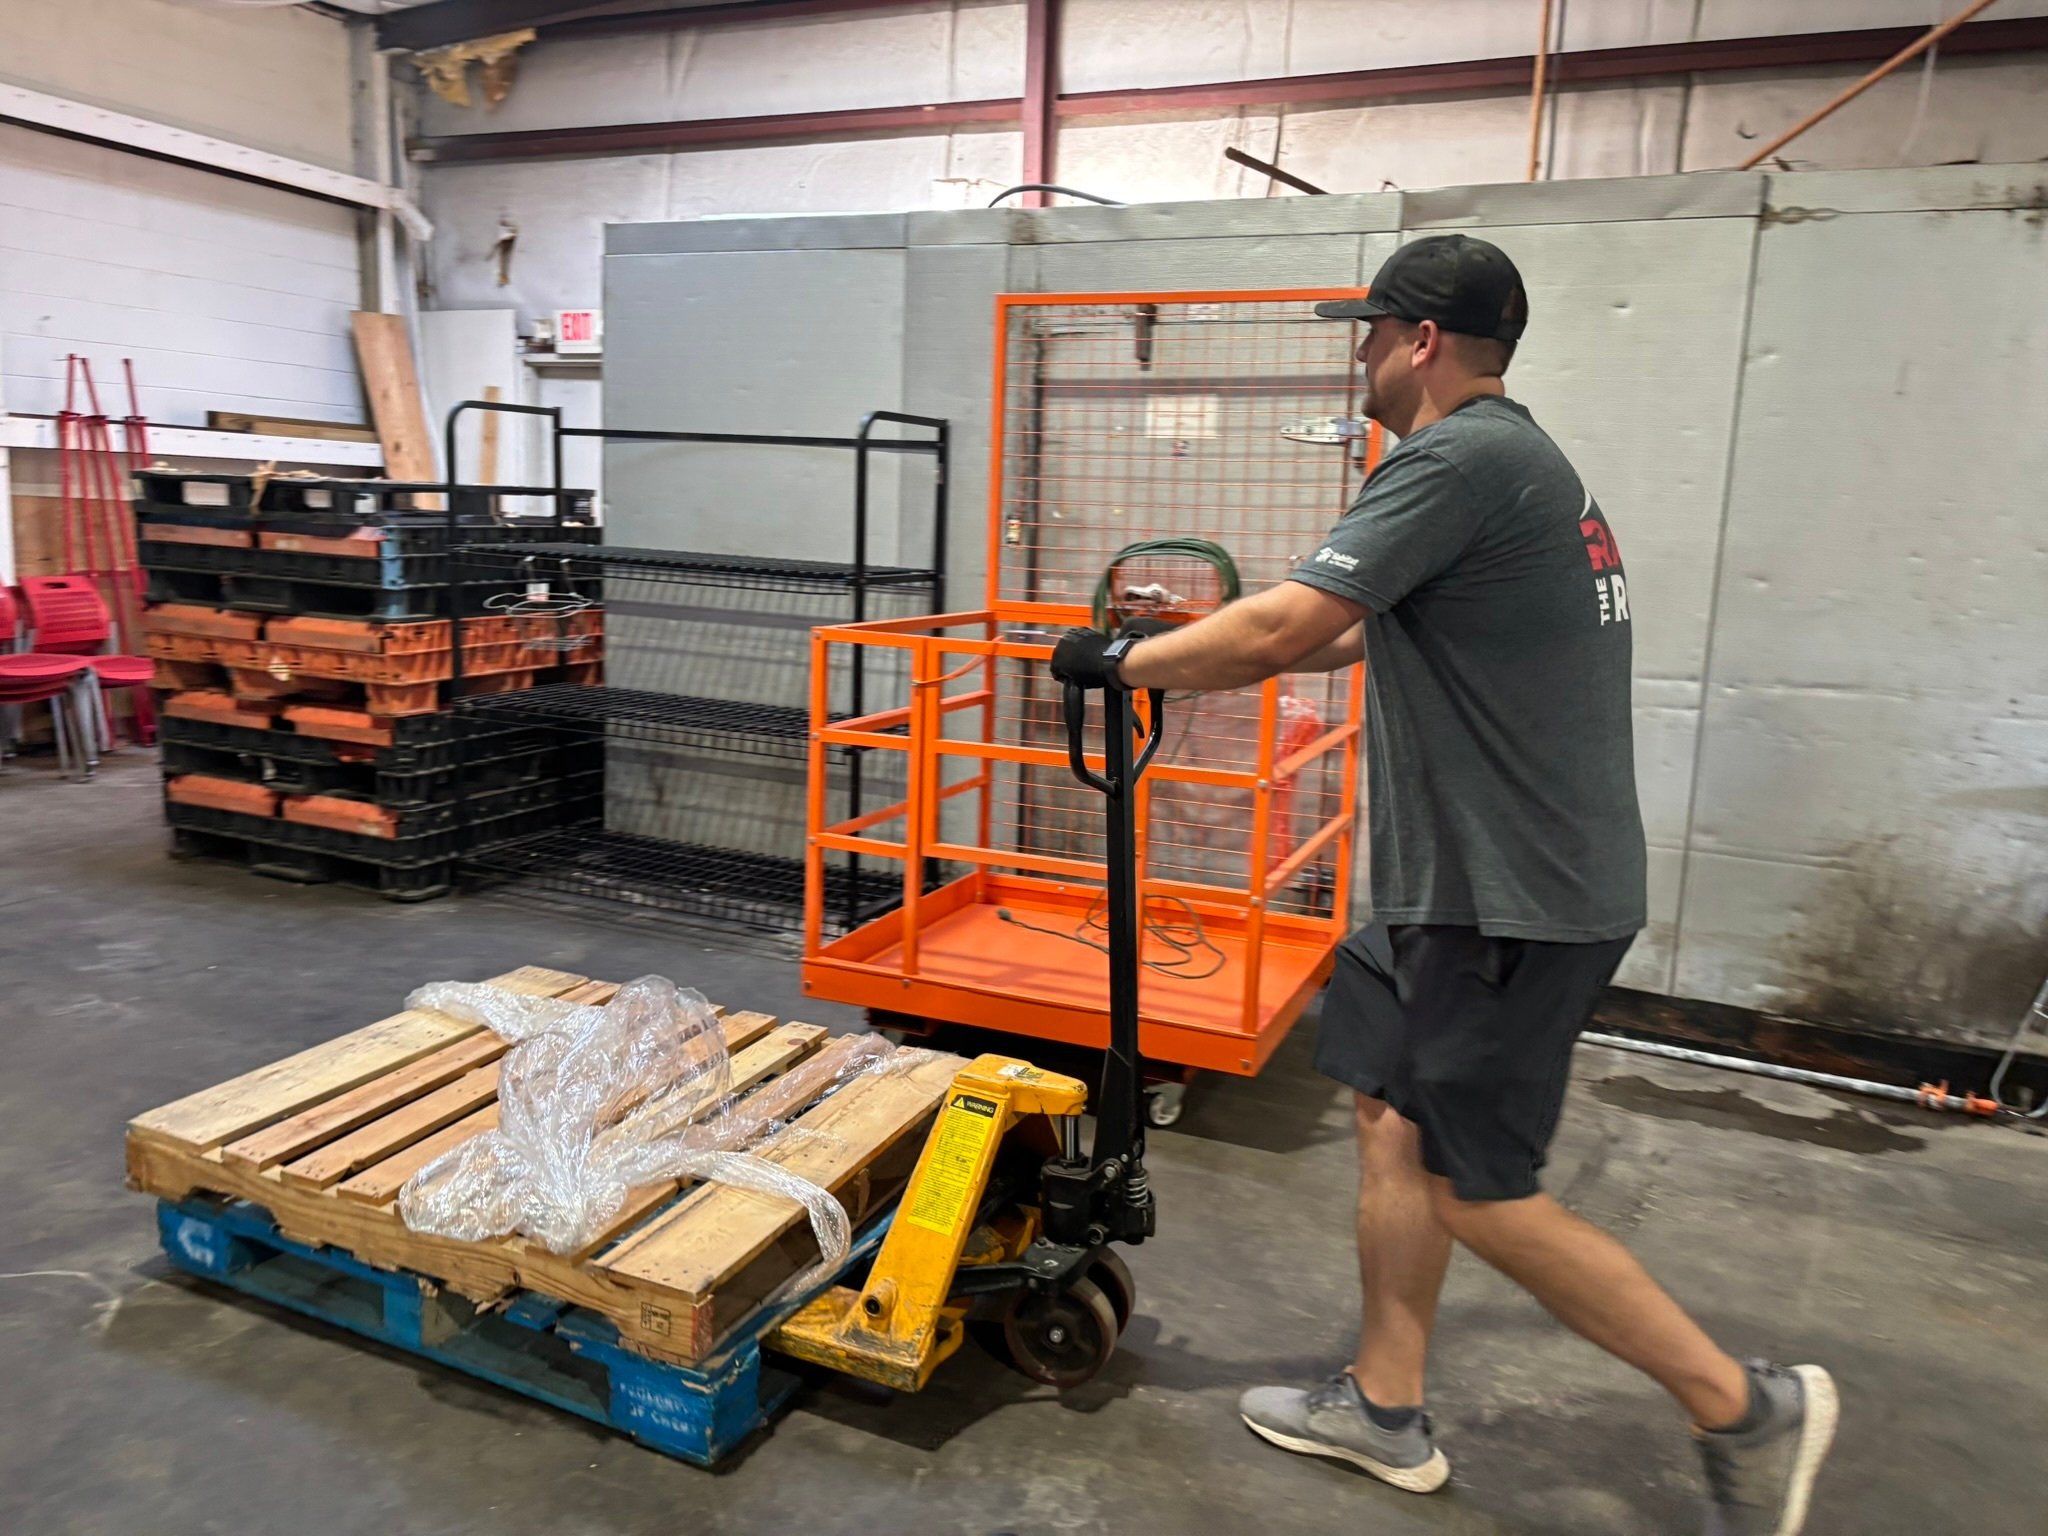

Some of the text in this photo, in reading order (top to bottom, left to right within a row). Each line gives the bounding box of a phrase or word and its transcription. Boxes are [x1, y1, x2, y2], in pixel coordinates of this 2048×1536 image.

[562, 312, 592, 340] EXIT
[1595, 577, 1611, 626] THE
[966, 1100, 994, 1113] WARNING
